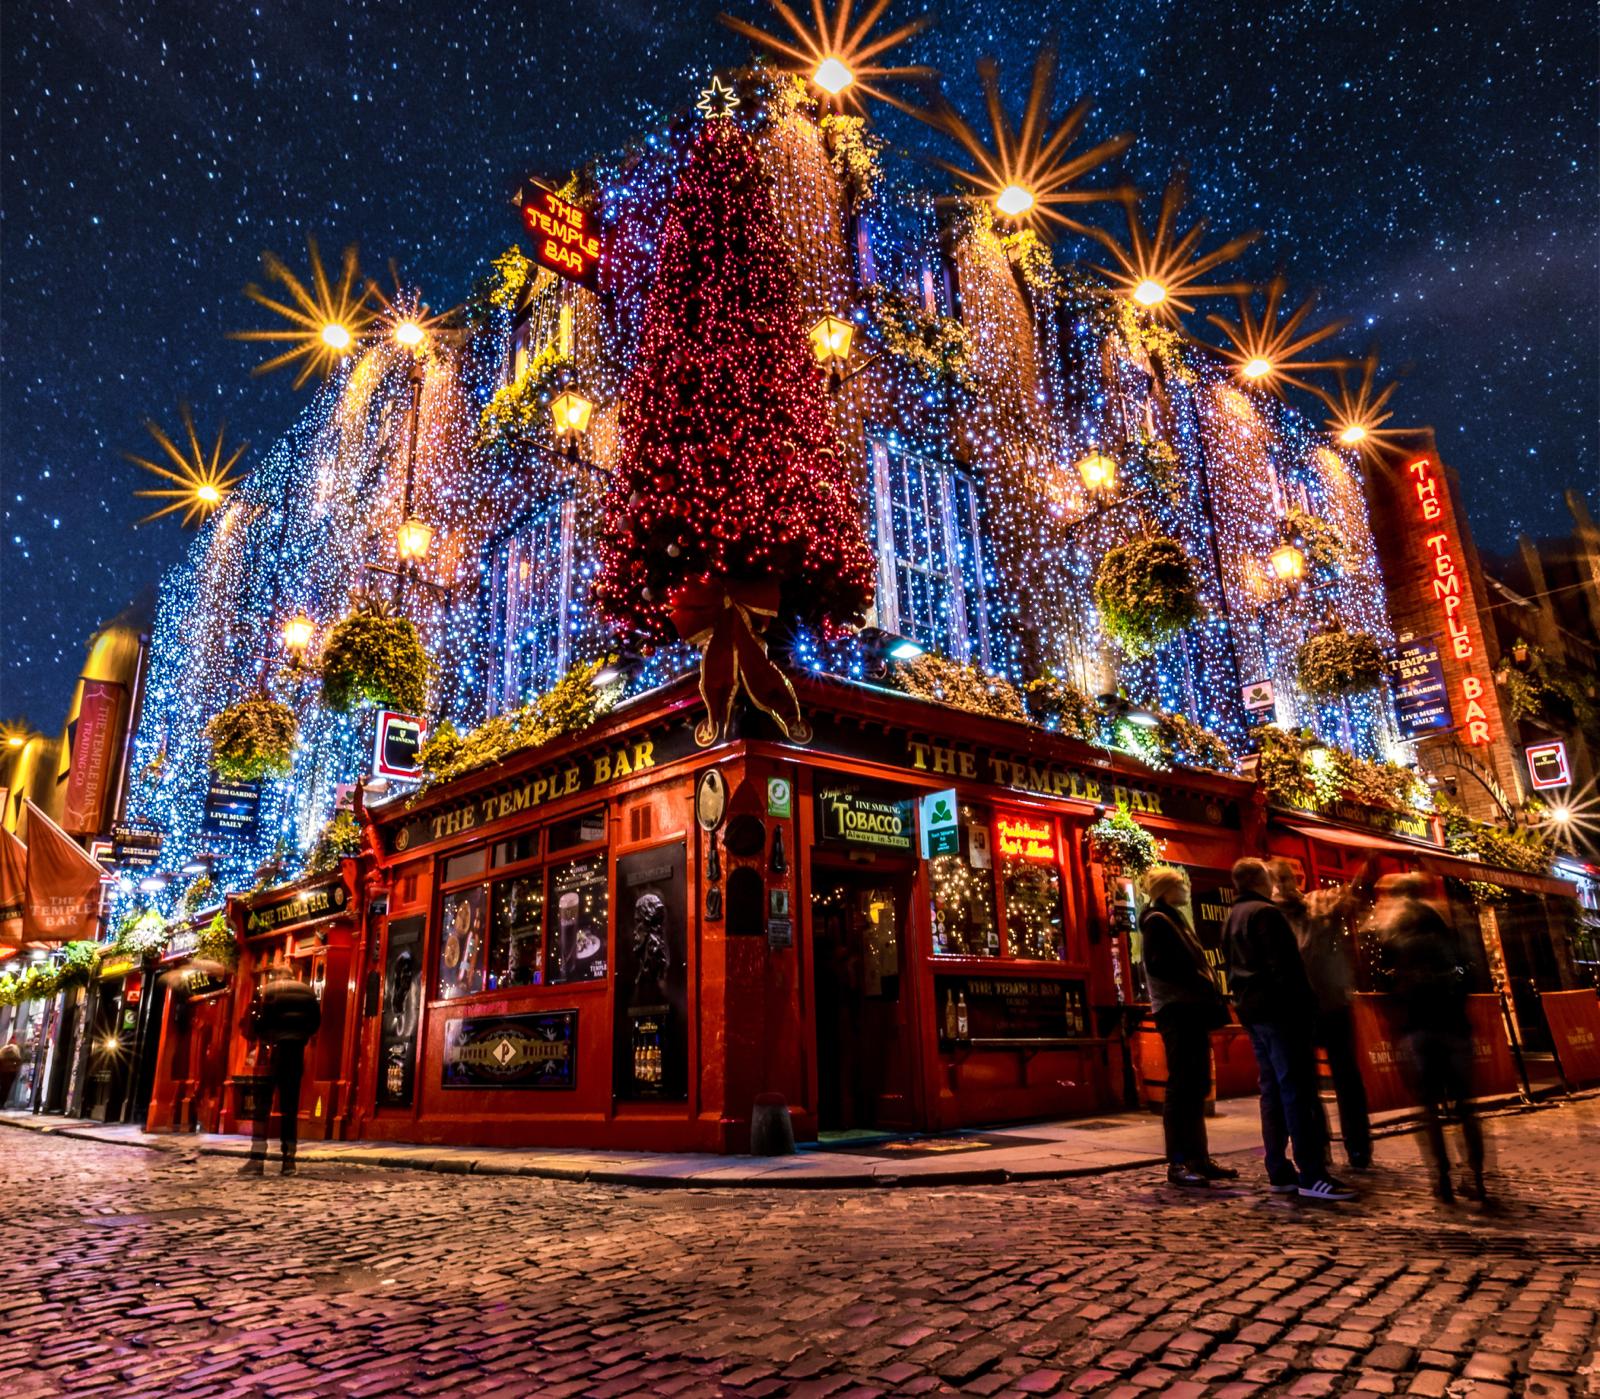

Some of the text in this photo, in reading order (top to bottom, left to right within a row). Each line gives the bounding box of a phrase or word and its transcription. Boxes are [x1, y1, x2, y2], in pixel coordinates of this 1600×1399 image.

[546, 194, 583, 229] THE
[527, 207, 600, 258] TEMPLE
[545, 239, 583, 273] BAR
[1410, 459, 1490, 744] THE TEMPLE BAR
[1389, 652, 1439, 671] TEMPLE
[1402, 648, 1420, 658] THE
[1401, 665, 1429, 679] BAR
[1401, 707, 1445, 722] LIVE MUSIC
[1412, 716, 1436, 727] DAILY
[77, 721, 93, 769] TRADING
[85, 705, 110, 806] THE TEMPLE BAR
[907, 740, 1164, 815] THE TEMPLE BAR
[230, 790, 258, 799] GARDEN
[432, 740, 656, 839] THE TEMPLE BAR
[855, 800, 901, 815] FINE SMOKING
[210, 811, 254, 822] LIVE MUSIC
[219, 820, 243, 828] DAILY
[831, 801, 902, 835] TOBACCO
[49, 896, 75, 905] THE
[276, 900, 309, 922] TEMPLE
[308, 892, 330, 913] BAR
[30, 903, 91, 916] TEMPLE
[46, 915, 77, 927] BAR
